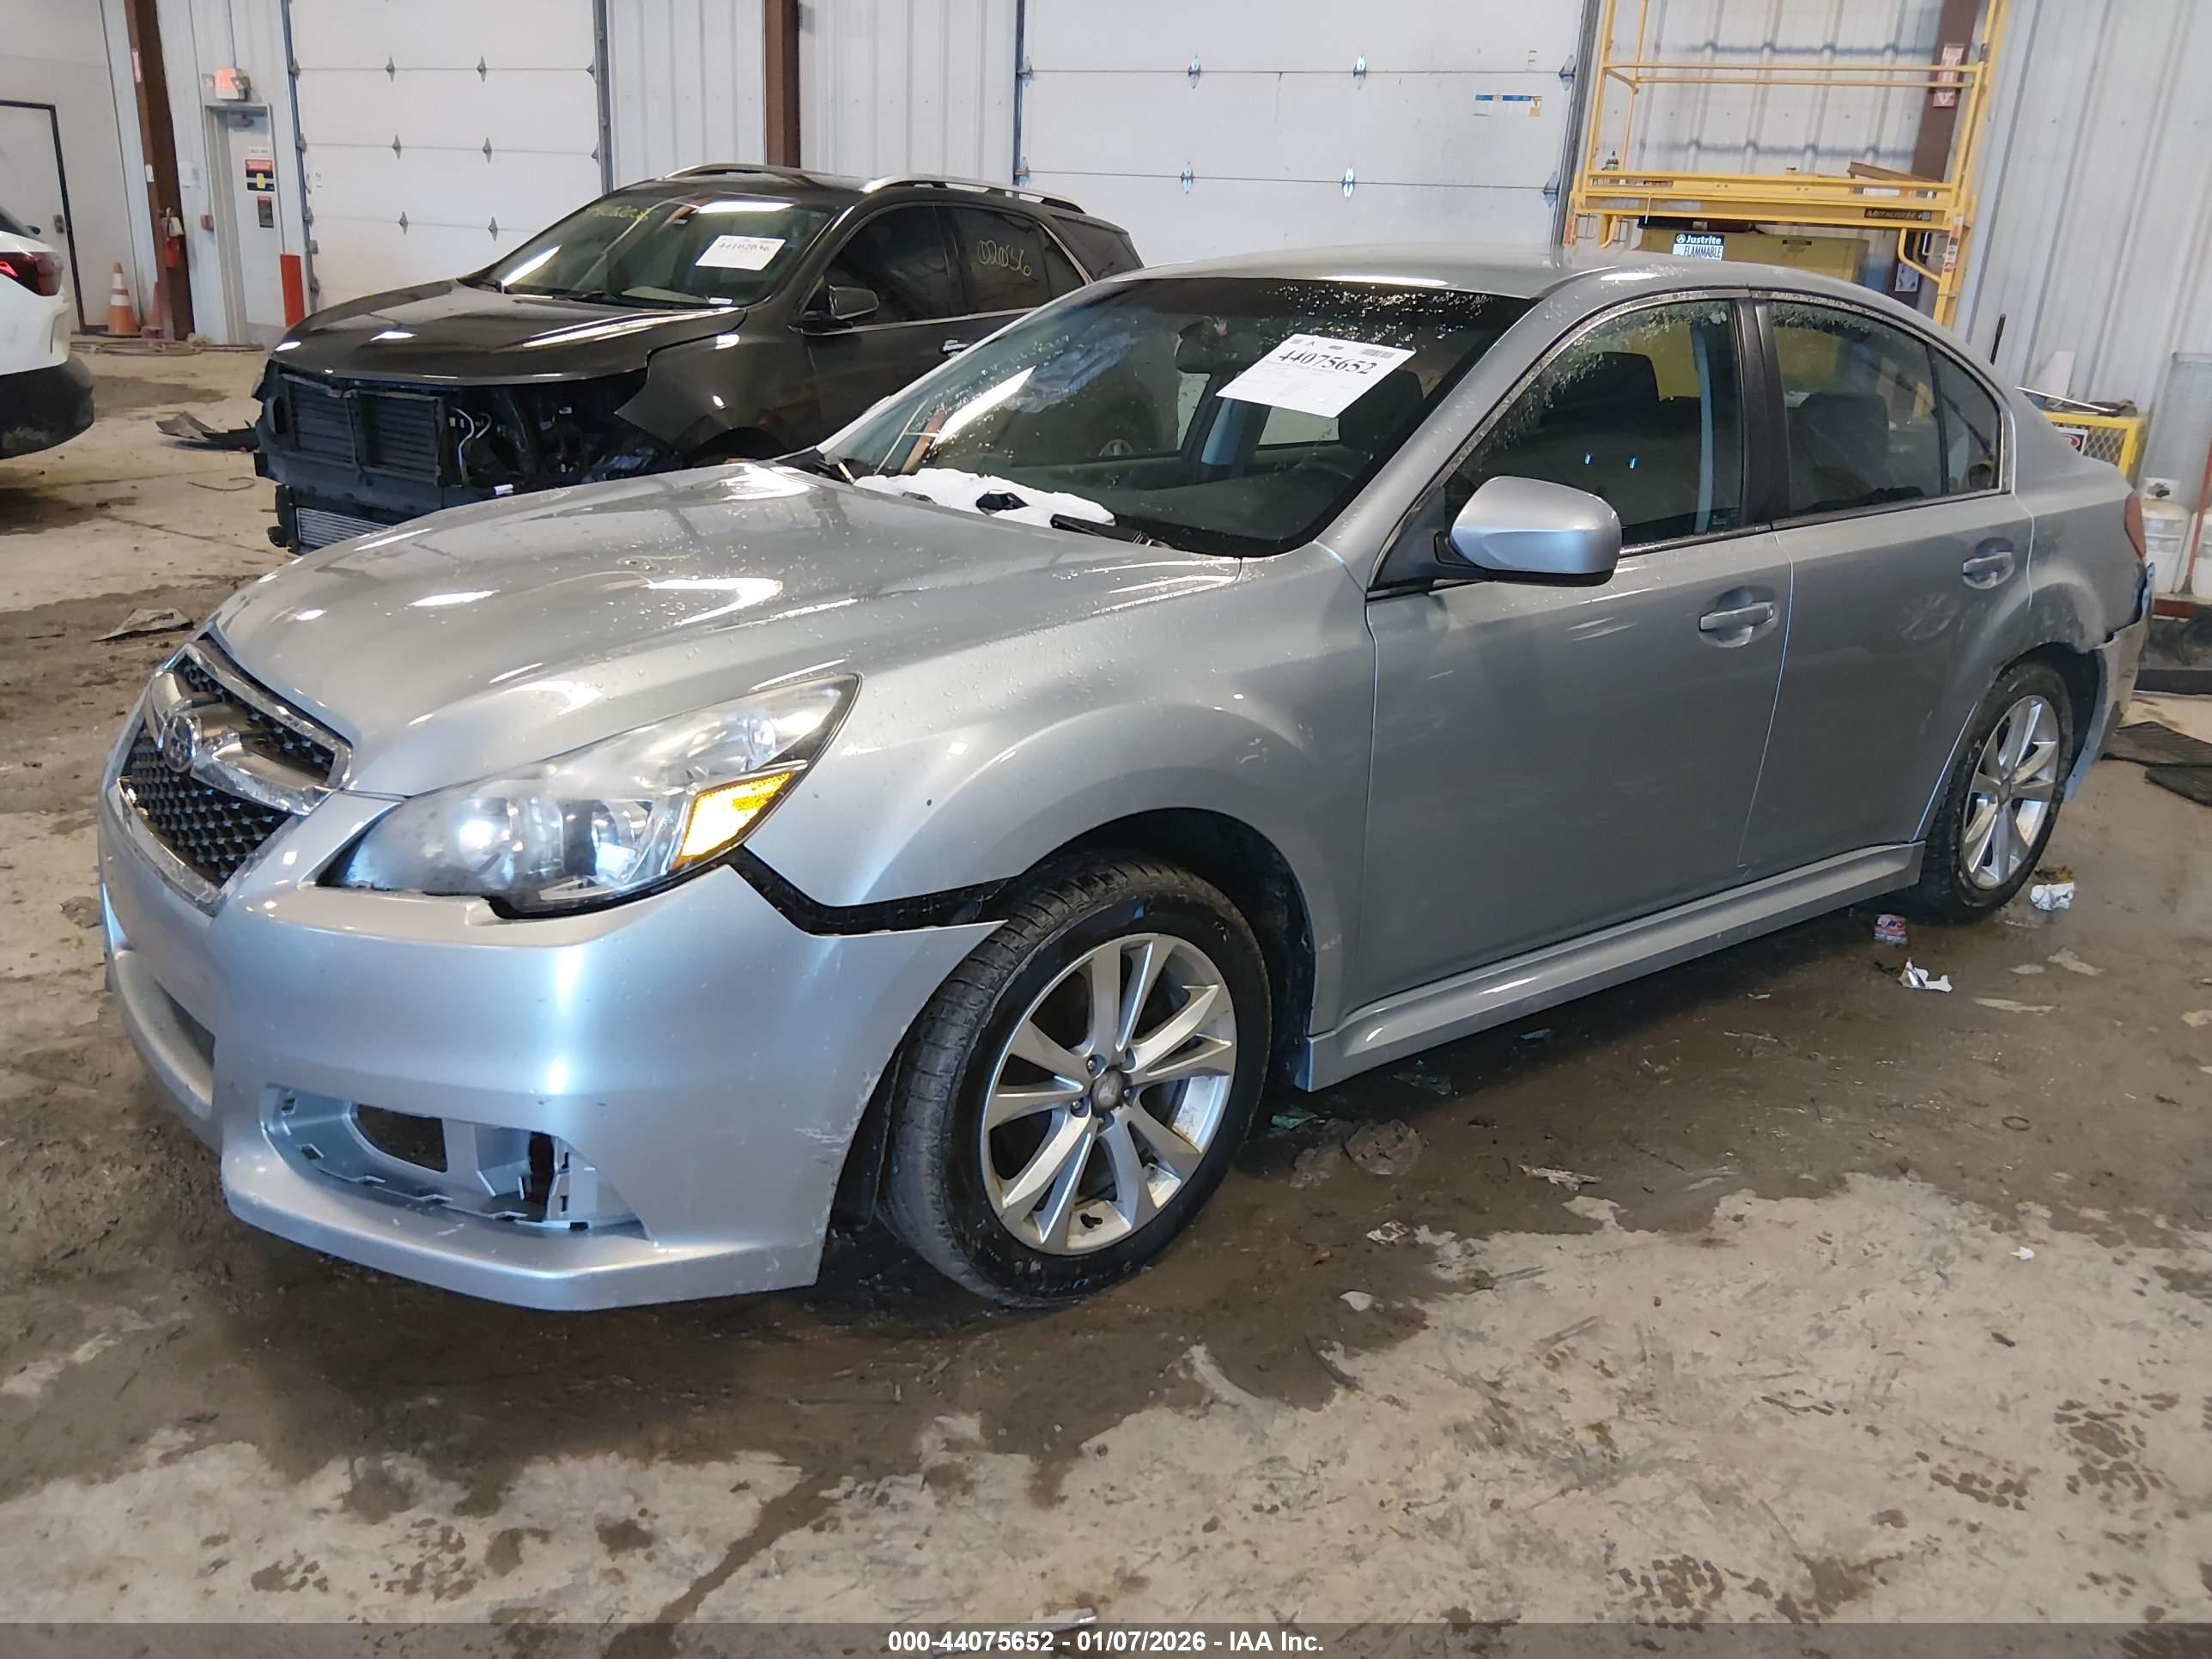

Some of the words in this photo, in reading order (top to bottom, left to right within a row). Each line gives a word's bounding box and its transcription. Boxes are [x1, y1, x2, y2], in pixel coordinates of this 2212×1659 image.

[1686, 234, 1722, 245] Justrite
[1684, 245, 1722, 258] FLAMMABLE
[1279, 349, 1377, 374] 44075652
